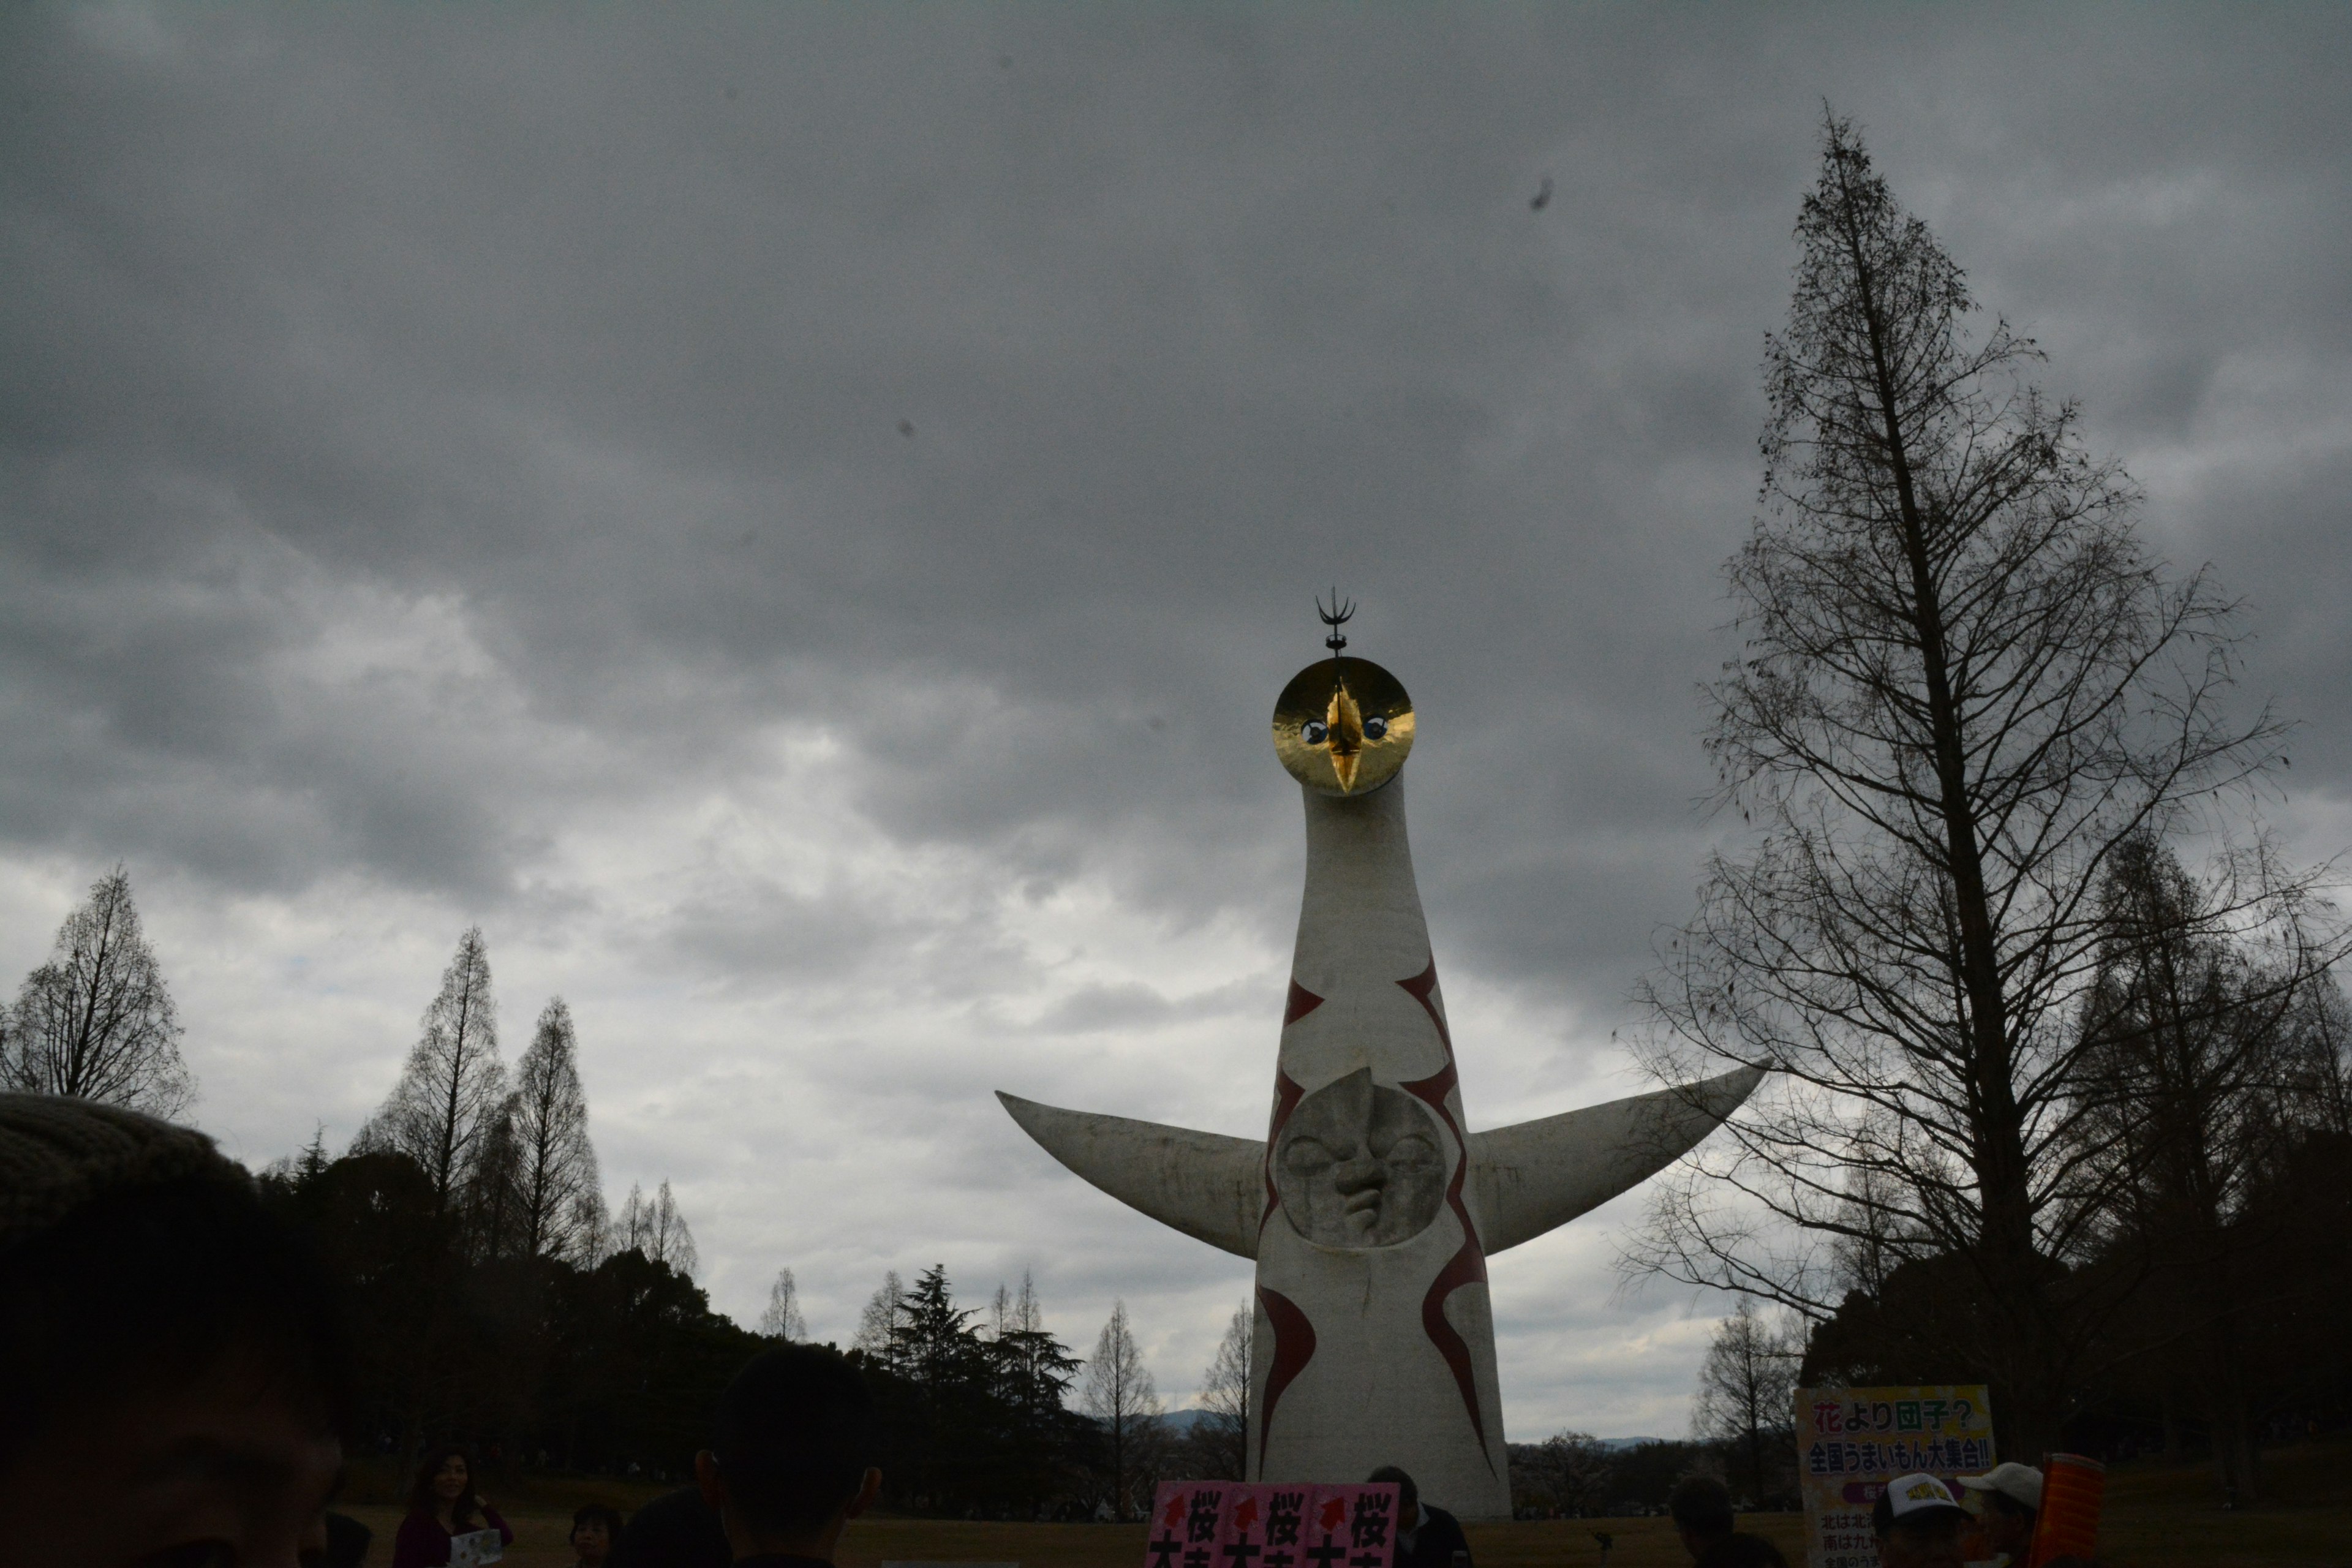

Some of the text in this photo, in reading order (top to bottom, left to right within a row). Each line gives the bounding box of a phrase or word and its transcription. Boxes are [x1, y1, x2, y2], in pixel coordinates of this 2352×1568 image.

[1813, 1400, 1972, 1433] 花より団子?
[1809, 1438, 1989, 1472] 全国うまいもん大集合!!
